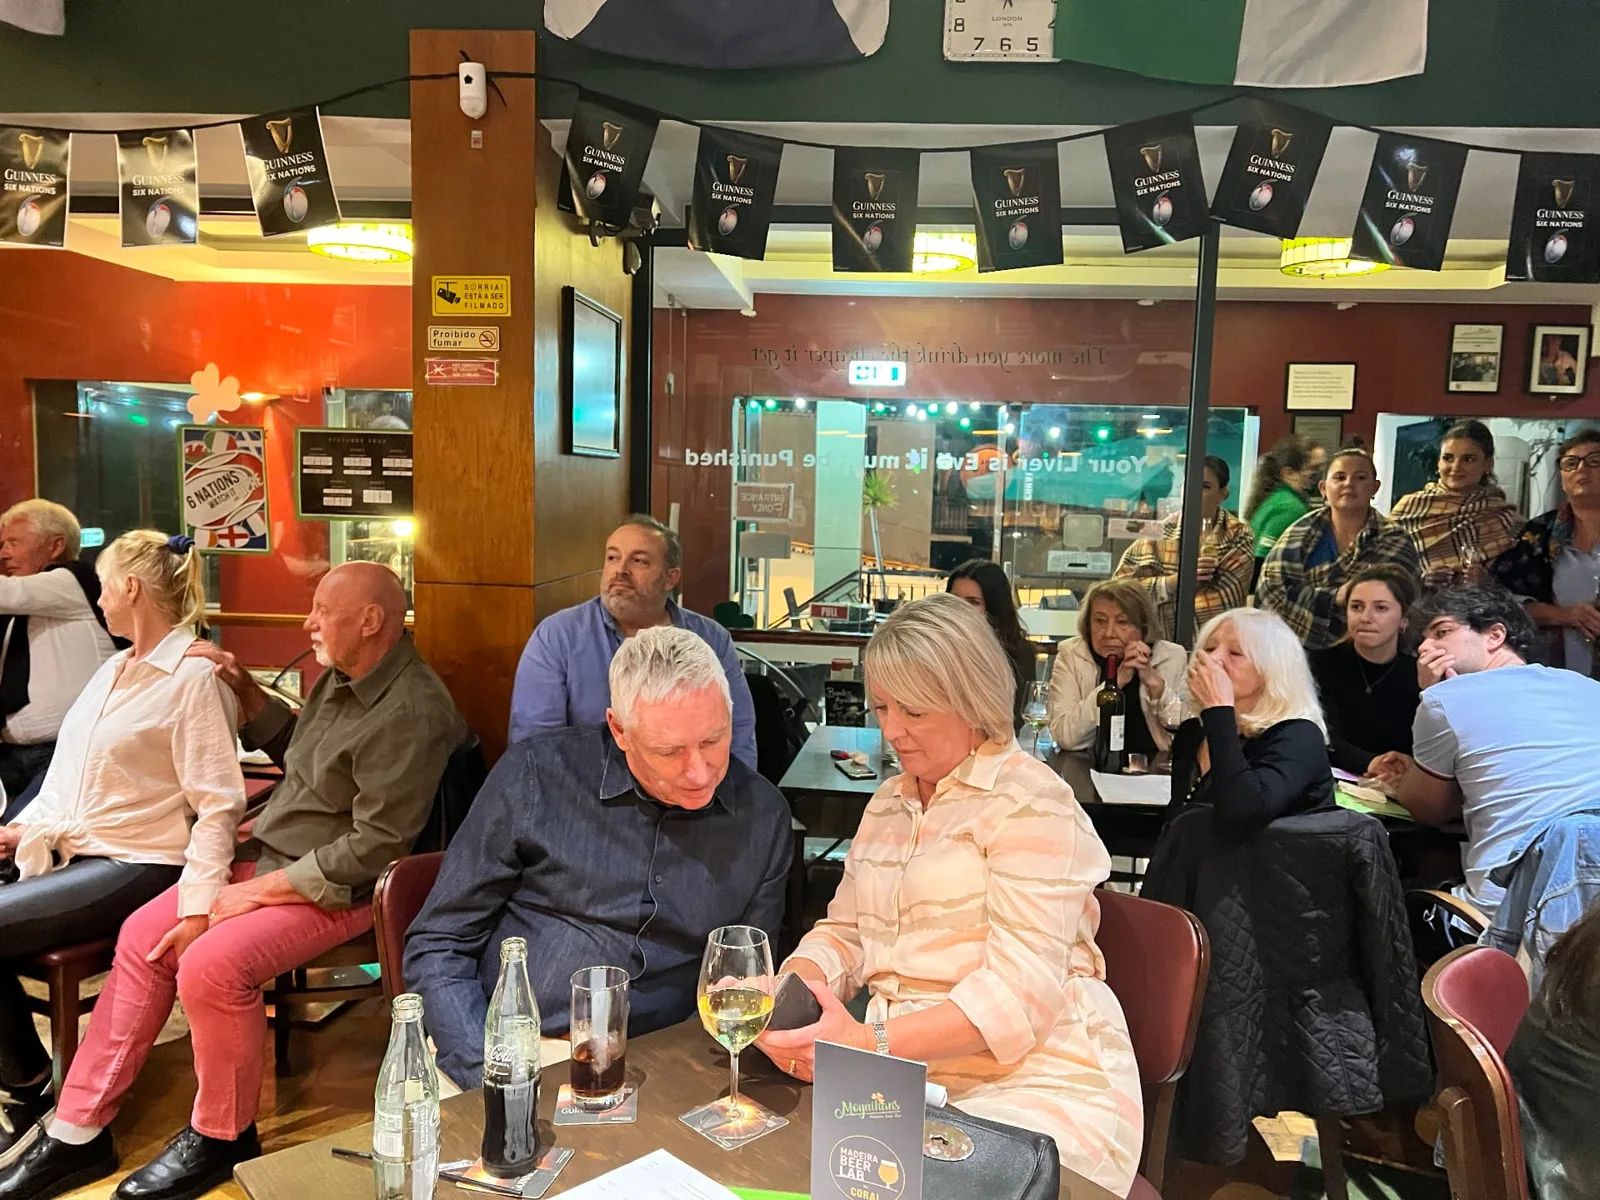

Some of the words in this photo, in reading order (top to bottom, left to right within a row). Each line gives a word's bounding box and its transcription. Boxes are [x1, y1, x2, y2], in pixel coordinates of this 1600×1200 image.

[953, 17, 965, 32] 8
[973, 37, 985, 51] 7
[1000, 37, 1012, 52] 6
[1026, 37, 1039, 52] 5
[584, 145, 626, 165] GUINNESS
[582, 156, 593, 164] SIX
[593, 159, 622, 172] NATIONS
[1250, 154, 1296, 173] GUINNESS
[4, 168, 57, 184] GUINNESS
[278, 164, 316, 179] NATIONS
[1134, 170, 1180, 187] GUINNESS
[1247, 165, 1258, 173] SIX
[1259, 168, 1292, 182] NATIONS
[132, 174, 185, 186] GUINNESS
[18, 184, 56, 195] NATIONS
[132, 188, 146, 196] SIX
[712, 181, 754, 196] GUINNESS
[1137, 188, 1148, 196] SIX
[1149, 181, 1181, 193] NATIONS
[722, 194, 752, 204] NATIONS
[994, 196, 1039, 208] GUINNESS
[1387, 189, 1434, 205] GUINNESS
[852, 201, 896, 211] GUINNESS
[1008, 207, 1039, 216] NATIONS
[1399, 203, 1431, 213] NATIONS
[1536, 208, 1585, 219] GUINNESS
[490, 292, 504, 300] SER
[433, 330, 476, 338] Proibido
[433, 338, 462, 347] fumar
[186, 495, 197, 510] 6
[194, 470, 240, 505] NATIONS
[490, 1044, 518, 1062] Cola
[840, 1146, 879, 1164] MADEIRA
[840, 1154, 872, 1173] BEER
[839, 1165, 865, 1181] LAB
